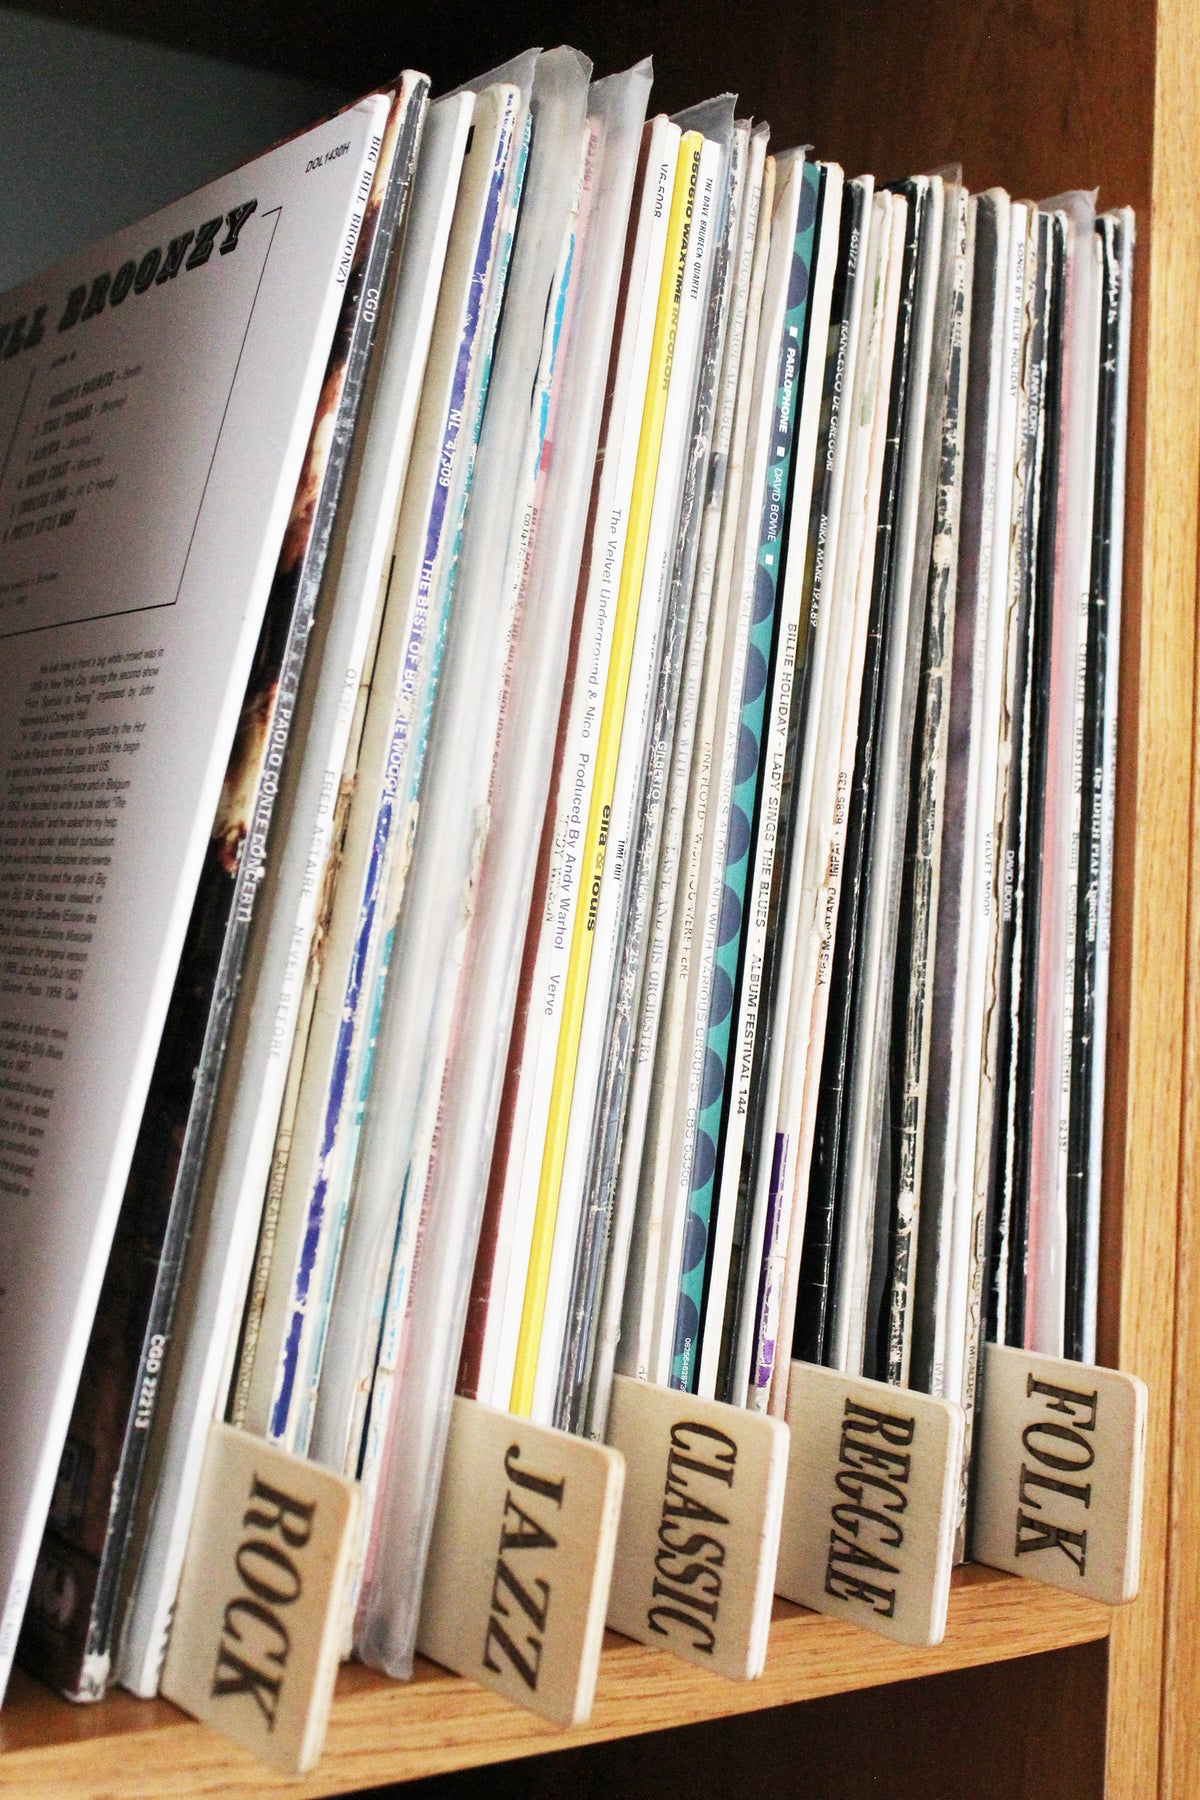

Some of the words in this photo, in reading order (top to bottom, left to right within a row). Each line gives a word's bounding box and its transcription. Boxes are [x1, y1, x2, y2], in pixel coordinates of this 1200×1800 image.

[367, 135, 381, 162] BIG
[356, 170, 372, 205] BILL
[684, 150, 701, 218] 950610
[703, 177, 712, 193] THE
[700, 195, 710, 217] DAVE
[334, 212, 362, 287] BROONZY
[694, 219, 706, 259] BRUBECK
[58, 199, 258, 332] BROONZY
[672, 222, 691, 304] WAXTIME
[689, 261, 701, 299] QUARTET
[1015, 242, 1024, 281] SONGS
[362, 287, 380, 323] CGD
[1013, 286, 1021, 301] BY
[1011, 306, 1020, 343] BILLIE
[661, 329, 676, 391] COLOR
[1008, 347, 1018, 397] HOLIDAY
[778, 347, 796, 433] PARLOPHONE
[831, 396, 840, 411] DE
[1028, 364, 1040, 402] HUNKY
[446, 408, 462, 431] NL
[437, 439, 456, 488] 47309
[771, 468, 783, 501] DAVID
[607, 507, 621, 534] The
[767, 504, 779, 541] BOWIE
[419, 557, 435, 590] THE
[601, 539, 617, 584] Velvet
[411, 594, 428, 634] BEST
[809, 586, 820, 627] 19.4.89
[407, 640, 421, 664] OF
[587, 588, 611, 685] Underground
[783, 623, 797, 666] BILLIE
[586, 690, 596, 700] &
[775, 671, 791, 736] HOLIDAY
[268, 707, 291, 766] PAOLO
[580, 705, 595, 739] Nico
[650, 740, 667, 800] GILBERTO
[769, 752, 783, 790] LADY
[1072, 717, 1084, 793] CHRISTIAN
[254, 769, 280, 828] CONTE
[569, 752, 590, 824] Produced
[718, 770, 731, 814] SINGS
[565, 829, 580, 848] By
[597, 804, 611, 846] ella
[764, 796, 778, 841] SINGS
[594, 851, 604, 869] &
[614, 839, 625, 860] TIME
[760, 848, 772, 875] THE
[1003, 849, 1015, 883] DAVID
[236, 832, 267, 923] CONCERTI
[560, 853, 577, 893] Andy
[611, 862, 622, 881] OUT
[553, 897, 571, 950] Warhol
[586, 874, 601, 932] louis
[755, 881, 769, 927] BLUES
[1001, 885, 1013, 921] BOWIE
[1067, 883, 1078, 945] Goodman
[650, 939, 665, 965] HIS
[705, 913, 717, 949] WITH
[543, 973, 560, 1016] Verve
[696, 955, 712, 1022] VARIOUS
[746, 954, 761, 1007] ALBUM
[1065, 957, 1075, 995] Sextet
[638, 970, 661, 1065] ORCHESTRA
[739, 1013, 755, 1083] FESTIVAL
[1061, 1030, 1072, 1093] Orchestra
[736, 1088, 748, 1115] 144
[144, 1332, 167, 1374] CGD
[1014, 1372, 1099, 1577] FOLK
[825, 1397, 915, 1620] REGGAE
[646, 1421, 739, 1656] CLASSIC
[482, 1444, 567, 1692] JAZZ
[209, 1471, 317, 1733] ROCK
